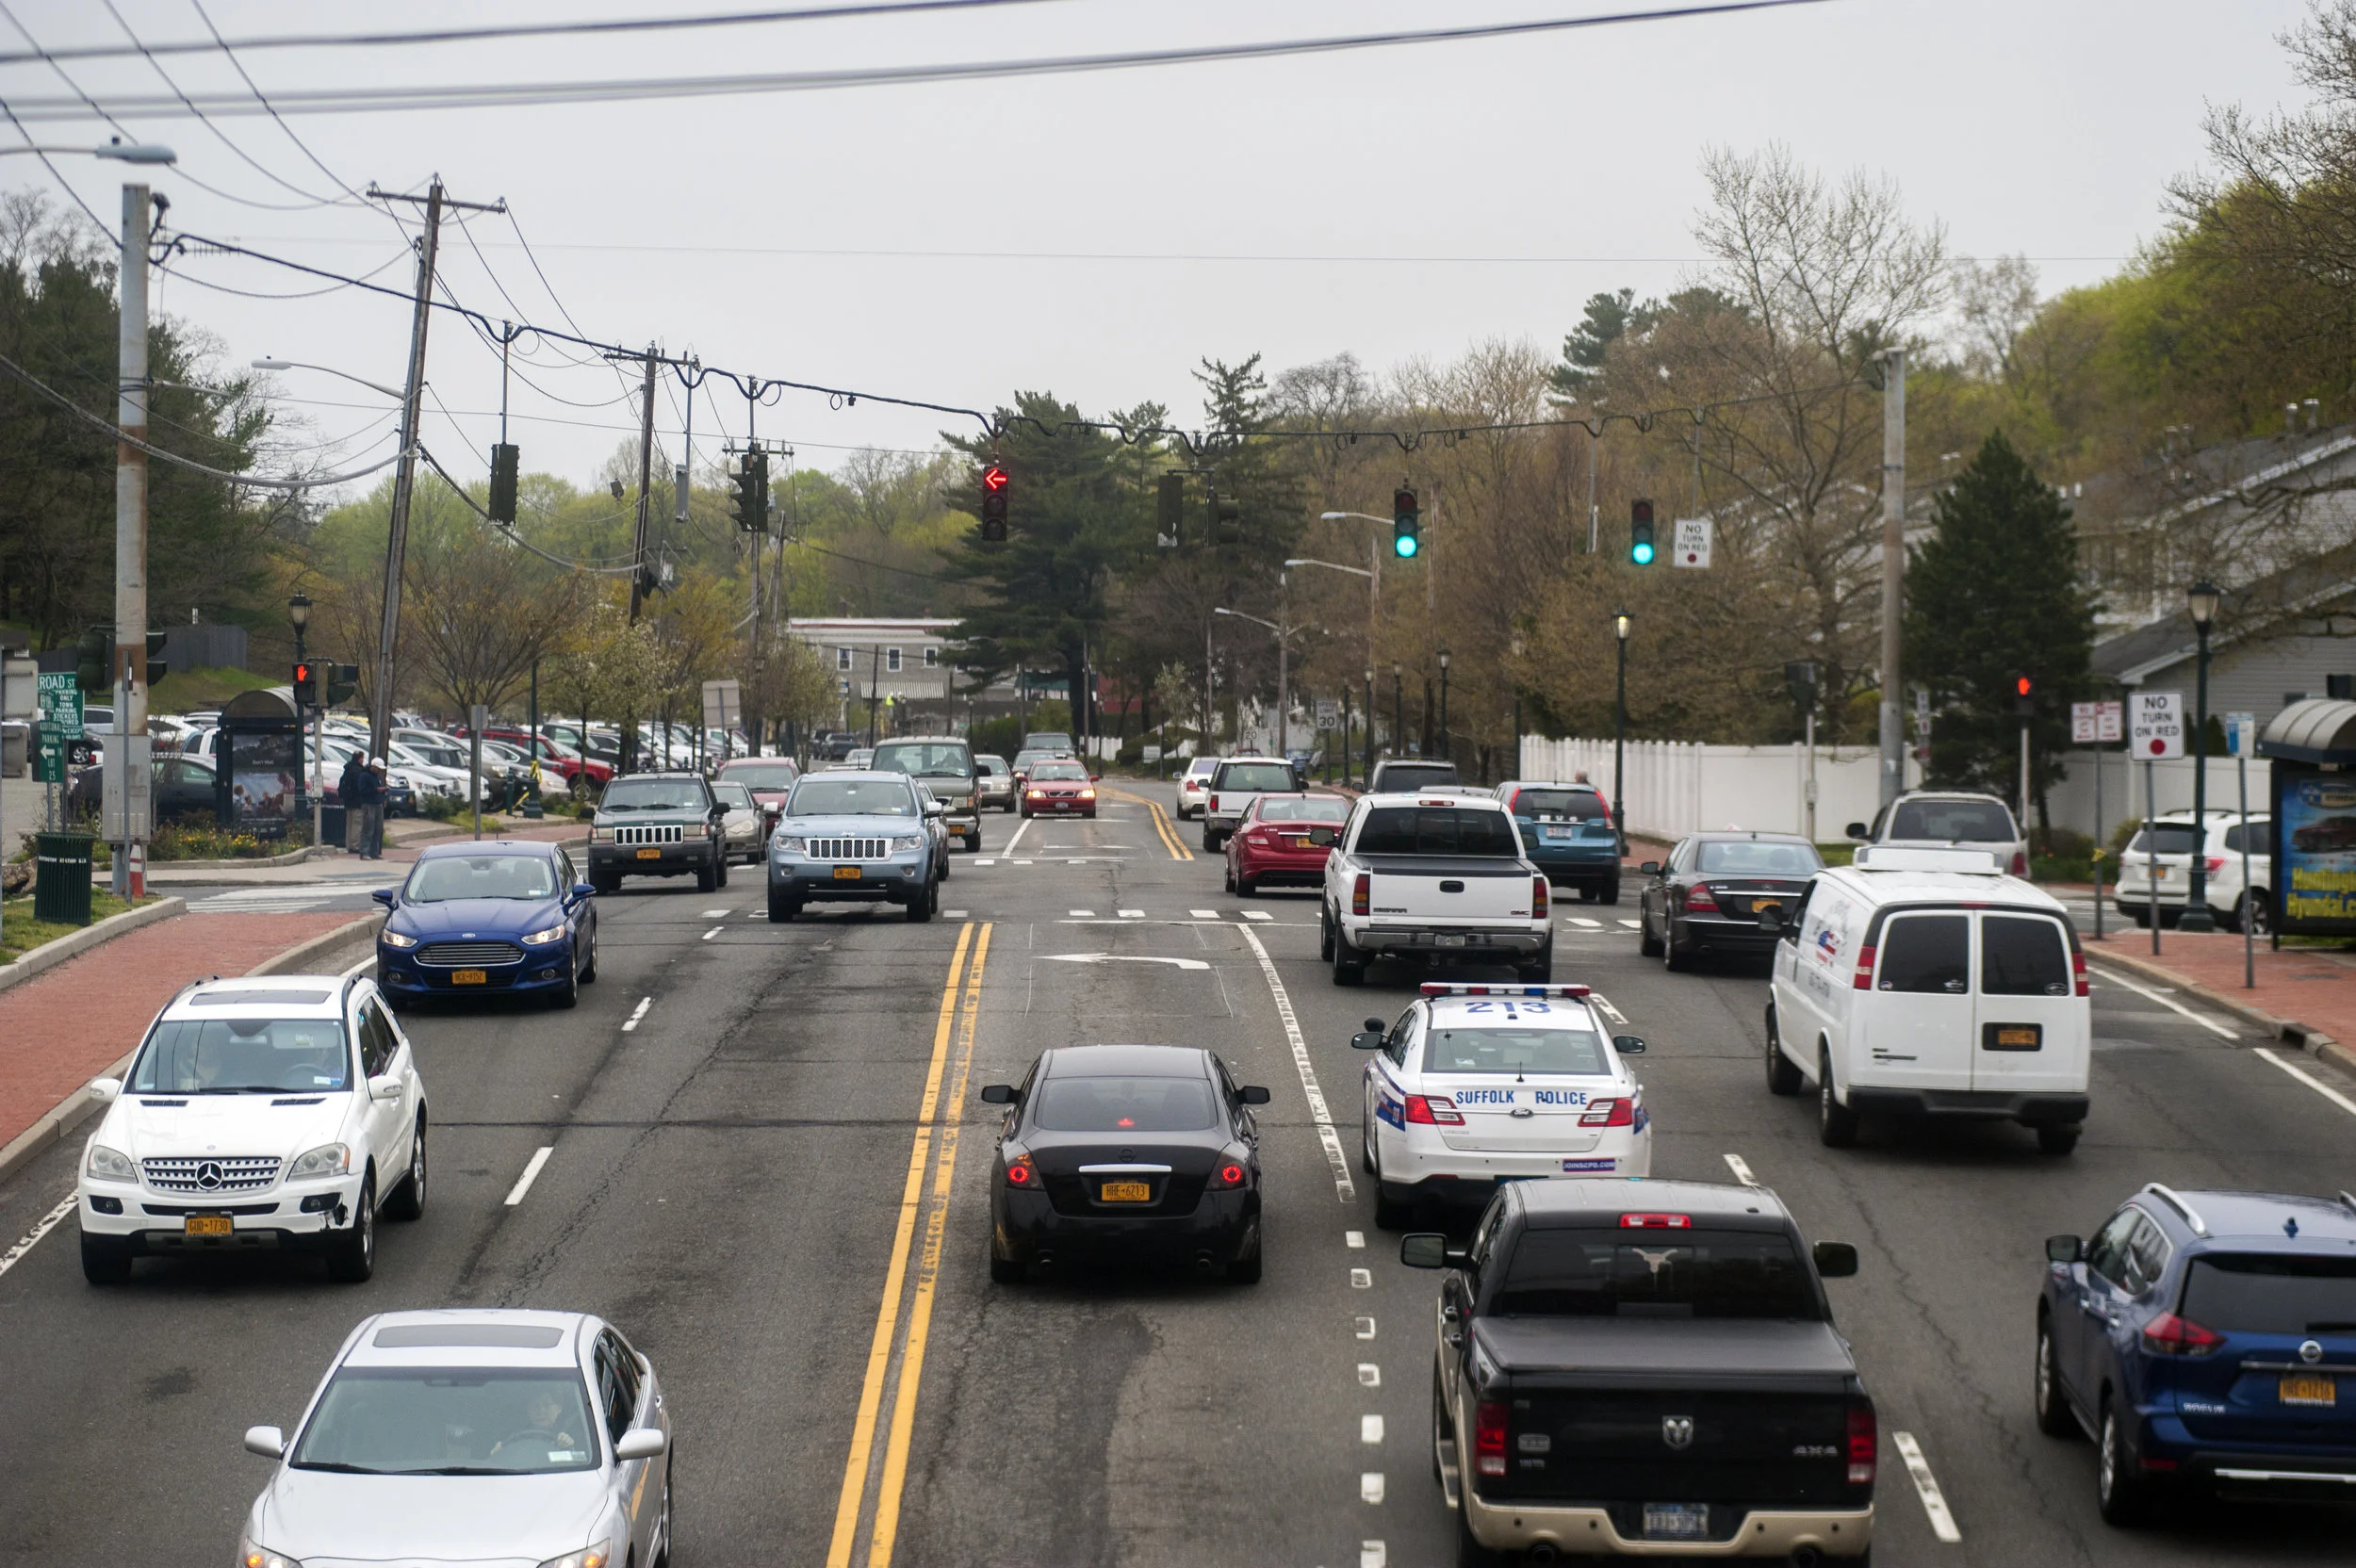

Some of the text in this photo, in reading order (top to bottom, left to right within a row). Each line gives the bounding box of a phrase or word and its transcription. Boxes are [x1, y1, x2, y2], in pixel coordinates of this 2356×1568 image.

[1685, 524, 1702, 533] NO
[1683, 534, 1704, 543] TURN
[1677, 543, 1708, 552] ON RED
[38, 675, 75, 689] ROAD ST
[2144, 696, 2168, 710] NO
[1319, 716, 1335, 727] 30
[2142, 712, 2173, 724] TURN
[2135, 725, 2181, 738] ON RED
[42, 734, 59, 744] PARKING
[49, 770, 57, 781] 25
[1464, 1002, 1552, 1014] 213
[1455, 1090, 1588, 1105] SUFFOLK POLICE
